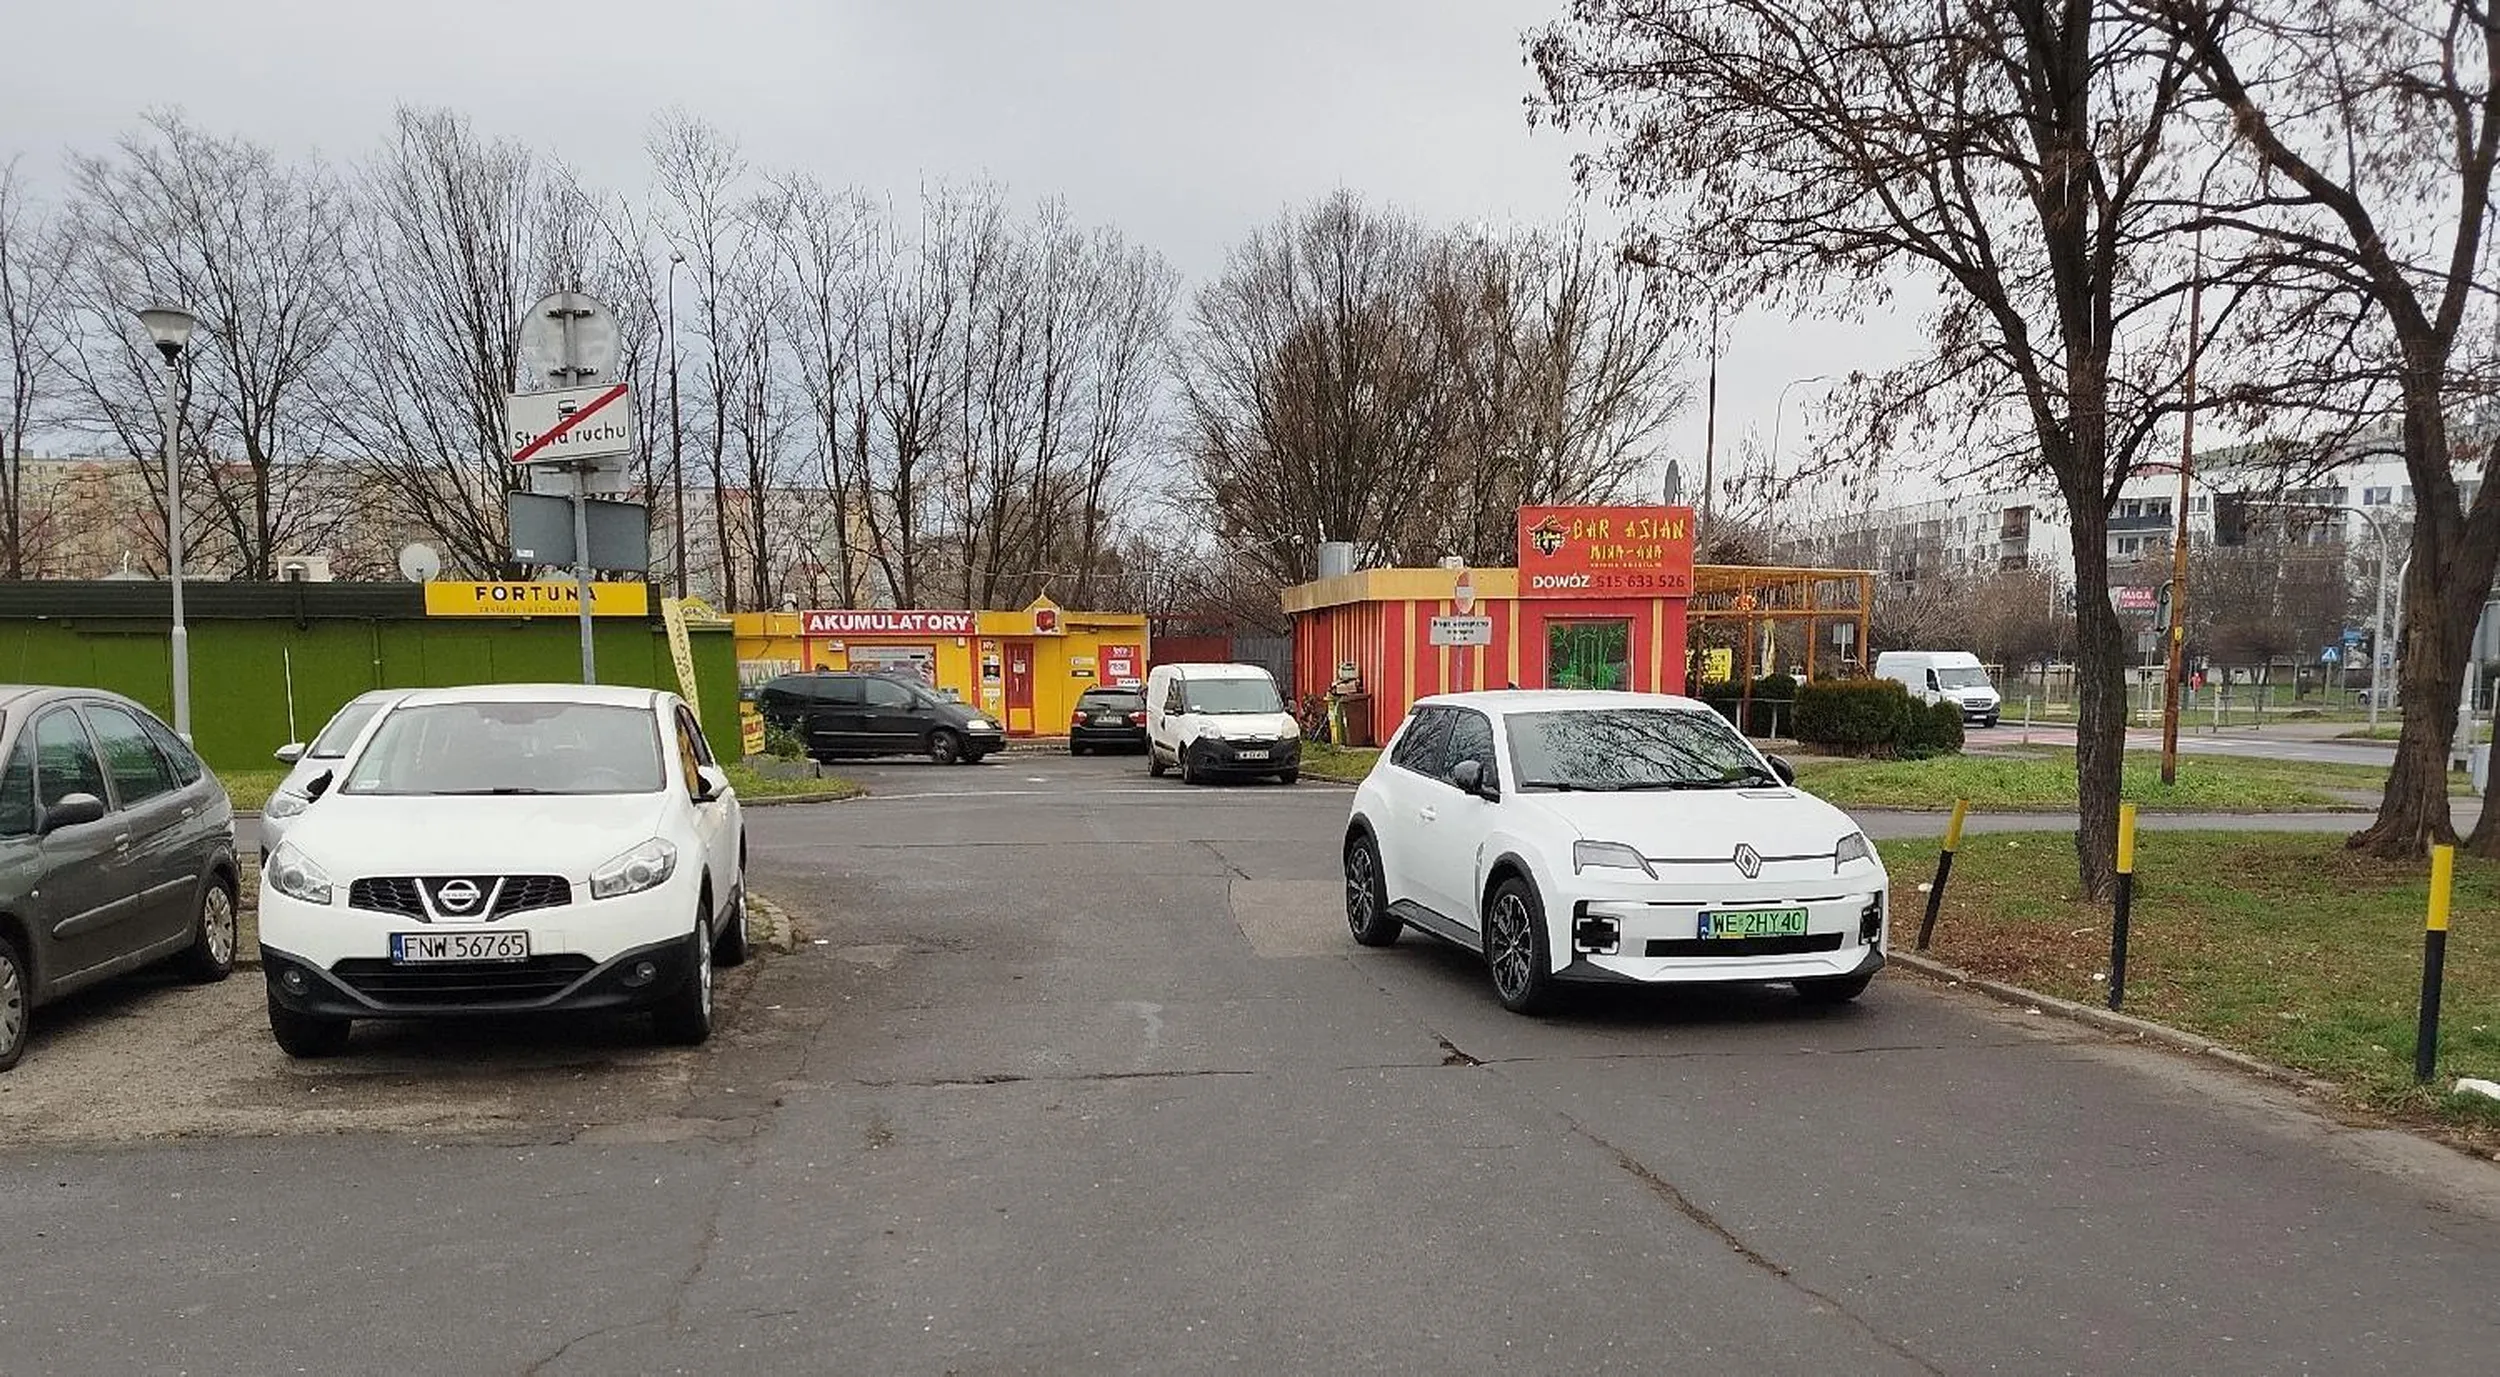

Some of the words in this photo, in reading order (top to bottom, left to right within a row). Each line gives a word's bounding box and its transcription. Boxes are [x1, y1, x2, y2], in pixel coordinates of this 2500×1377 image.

[575, 422, 626, 443] ruchu
[1573, 518, 1610, 541] BAR
[1624, 518, 1685, 541] ASIAN
[1532, 573, 1591, 588] DOWÓZ
[1596, 575, 1622, 588] 515
[1658, 575, 1685, 588] 526
[475, 586, 598, 601] FORTUNA
[809, 614, 970, 631] AKUMULATORY
[1713, 914, 1737, 933] WE
[1745, 912, 1802, 933] 2HY40
[403, 937, 447, 958] FNW
[455, 935, 524, 958] 56765
